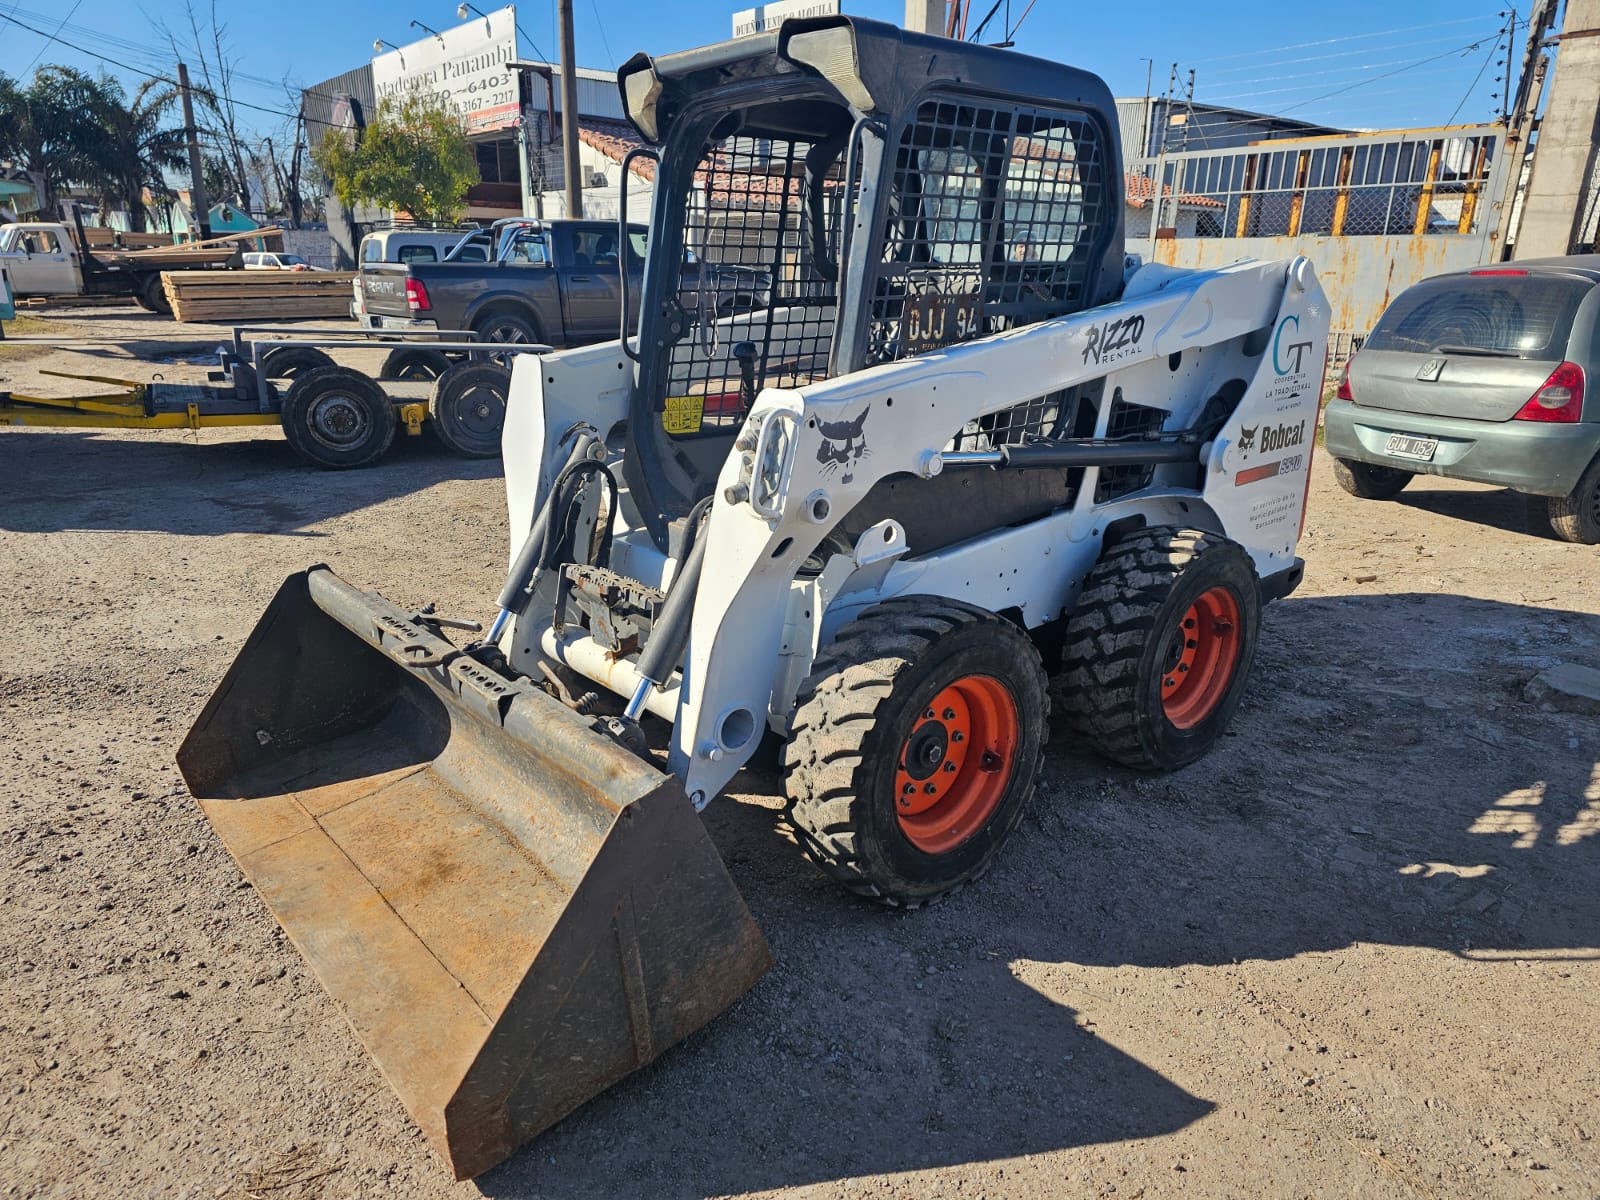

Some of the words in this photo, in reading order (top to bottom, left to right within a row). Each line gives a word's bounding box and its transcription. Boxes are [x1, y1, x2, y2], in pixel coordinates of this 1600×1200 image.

[736, 19, 761, 36] DUEÑO
[442, 40, 513, 81] Panambi
[463, 97, 482, 113] 3167
[493, 89, 514, 106] 2217
[1082, 314, 1145, 365] RIZZO
[1102, 346, 1142, 364] RENTAL
[1274, 373, 1306, 384] COOPERATIVA
[1275, 382, 1311, 396] TRADICIONAL
[1260, 419, 1305, 453] Bobcat
[1411, 441, 1434, 456] 052
